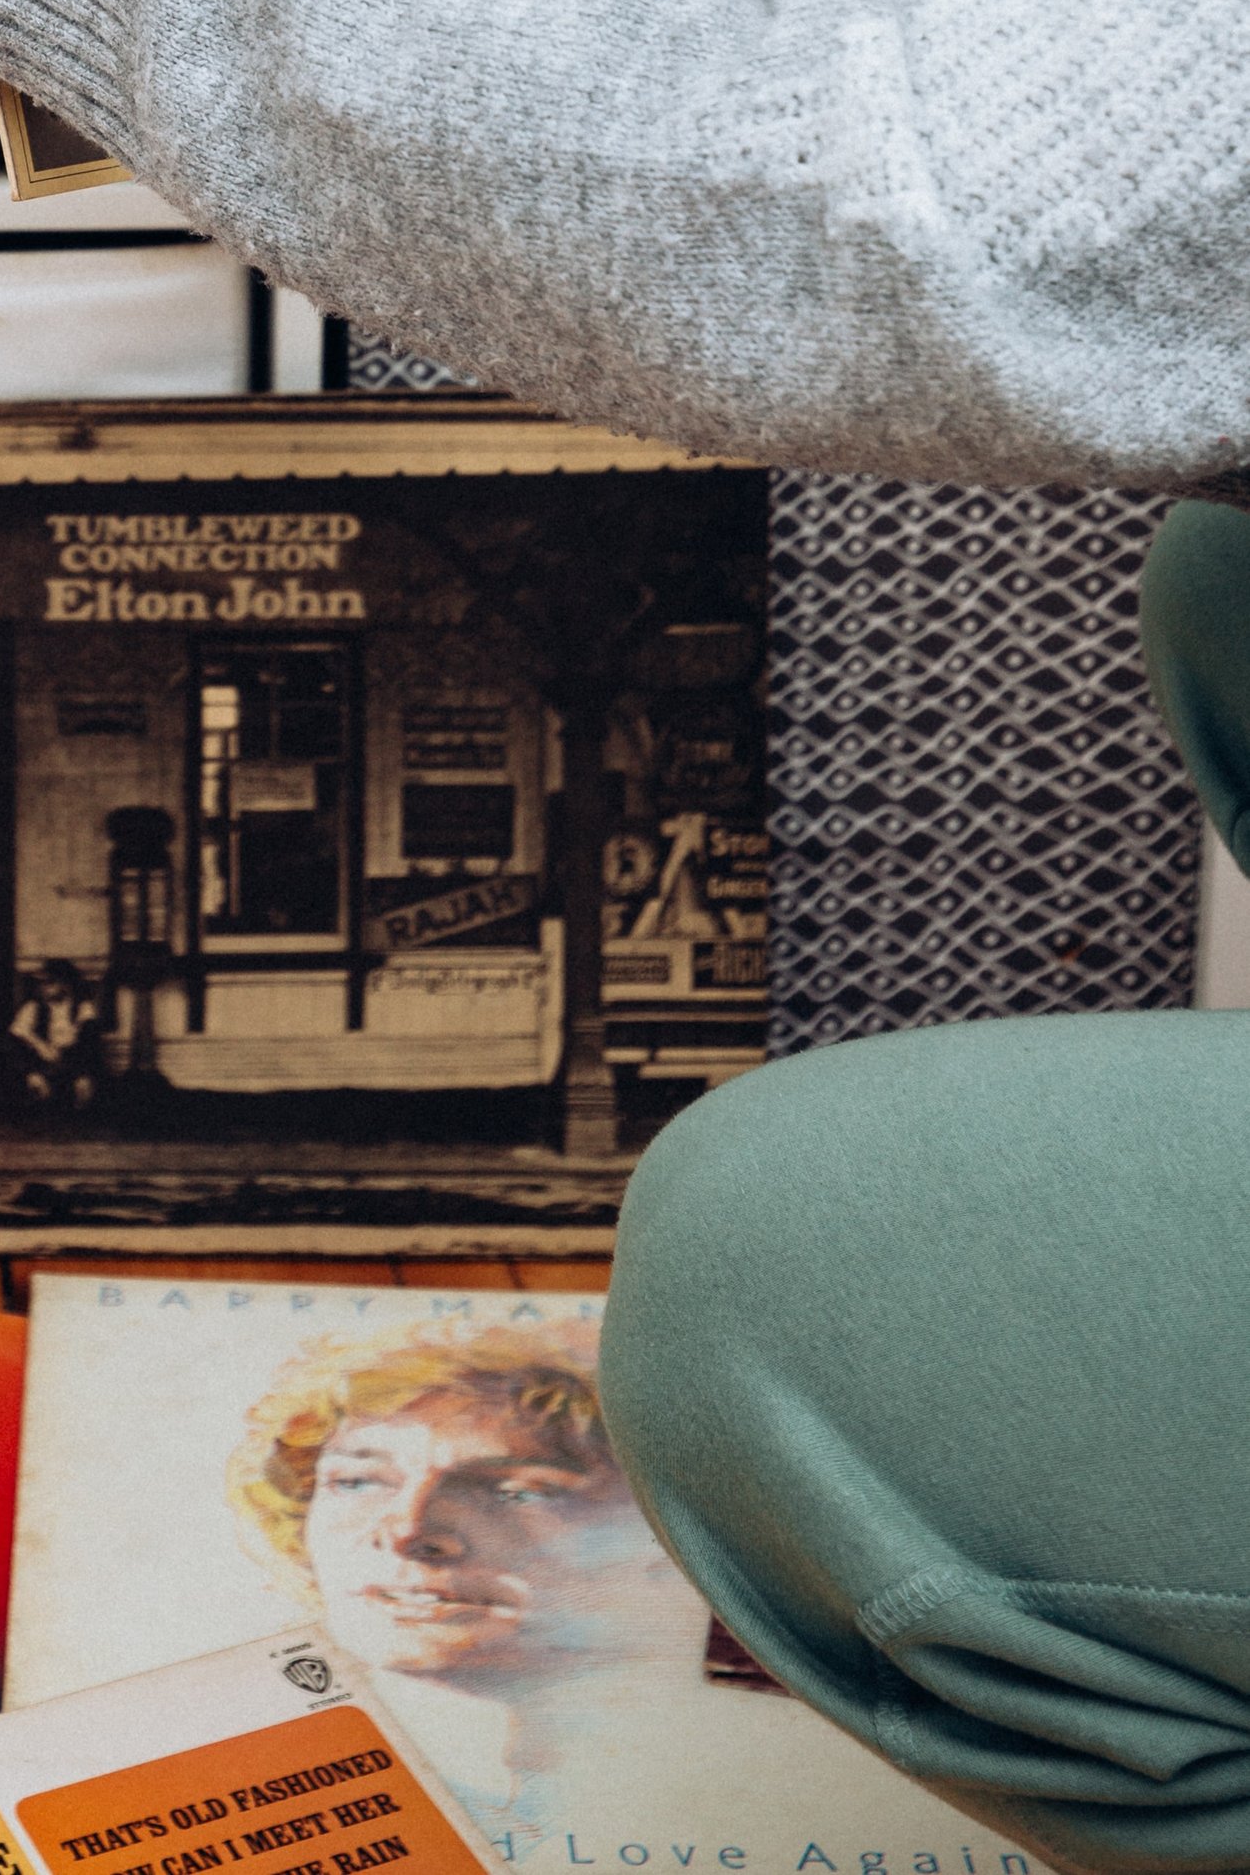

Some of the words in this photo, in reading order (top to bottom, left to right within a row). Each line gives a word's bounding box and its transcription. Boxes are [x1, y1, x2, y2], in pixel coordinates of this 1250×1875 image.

[46, 513, 362, 544] TUMBLEWEED
[59, 542, 342, 573] CONNECTION
[44, 578, 211, 622] Elton
[216, 577, 367, 621] John
[60, 1804, 170, 1862] THAT'S
[168, 1796, 229, 1832] OLD
[228, 1748, 394, 1814] FASHIONED
[159, 1844, 228, 1875] CAN
[220, 1838, 242, 1862] I
[248, 1810, 331, 1856] MEET
[330, 1791, 403, 1830] HER
[566, 1833, 748, 1870] Love
[796, 1841, 1031, 1875] Again
[327, 1835, 411, 1875] RAIN
